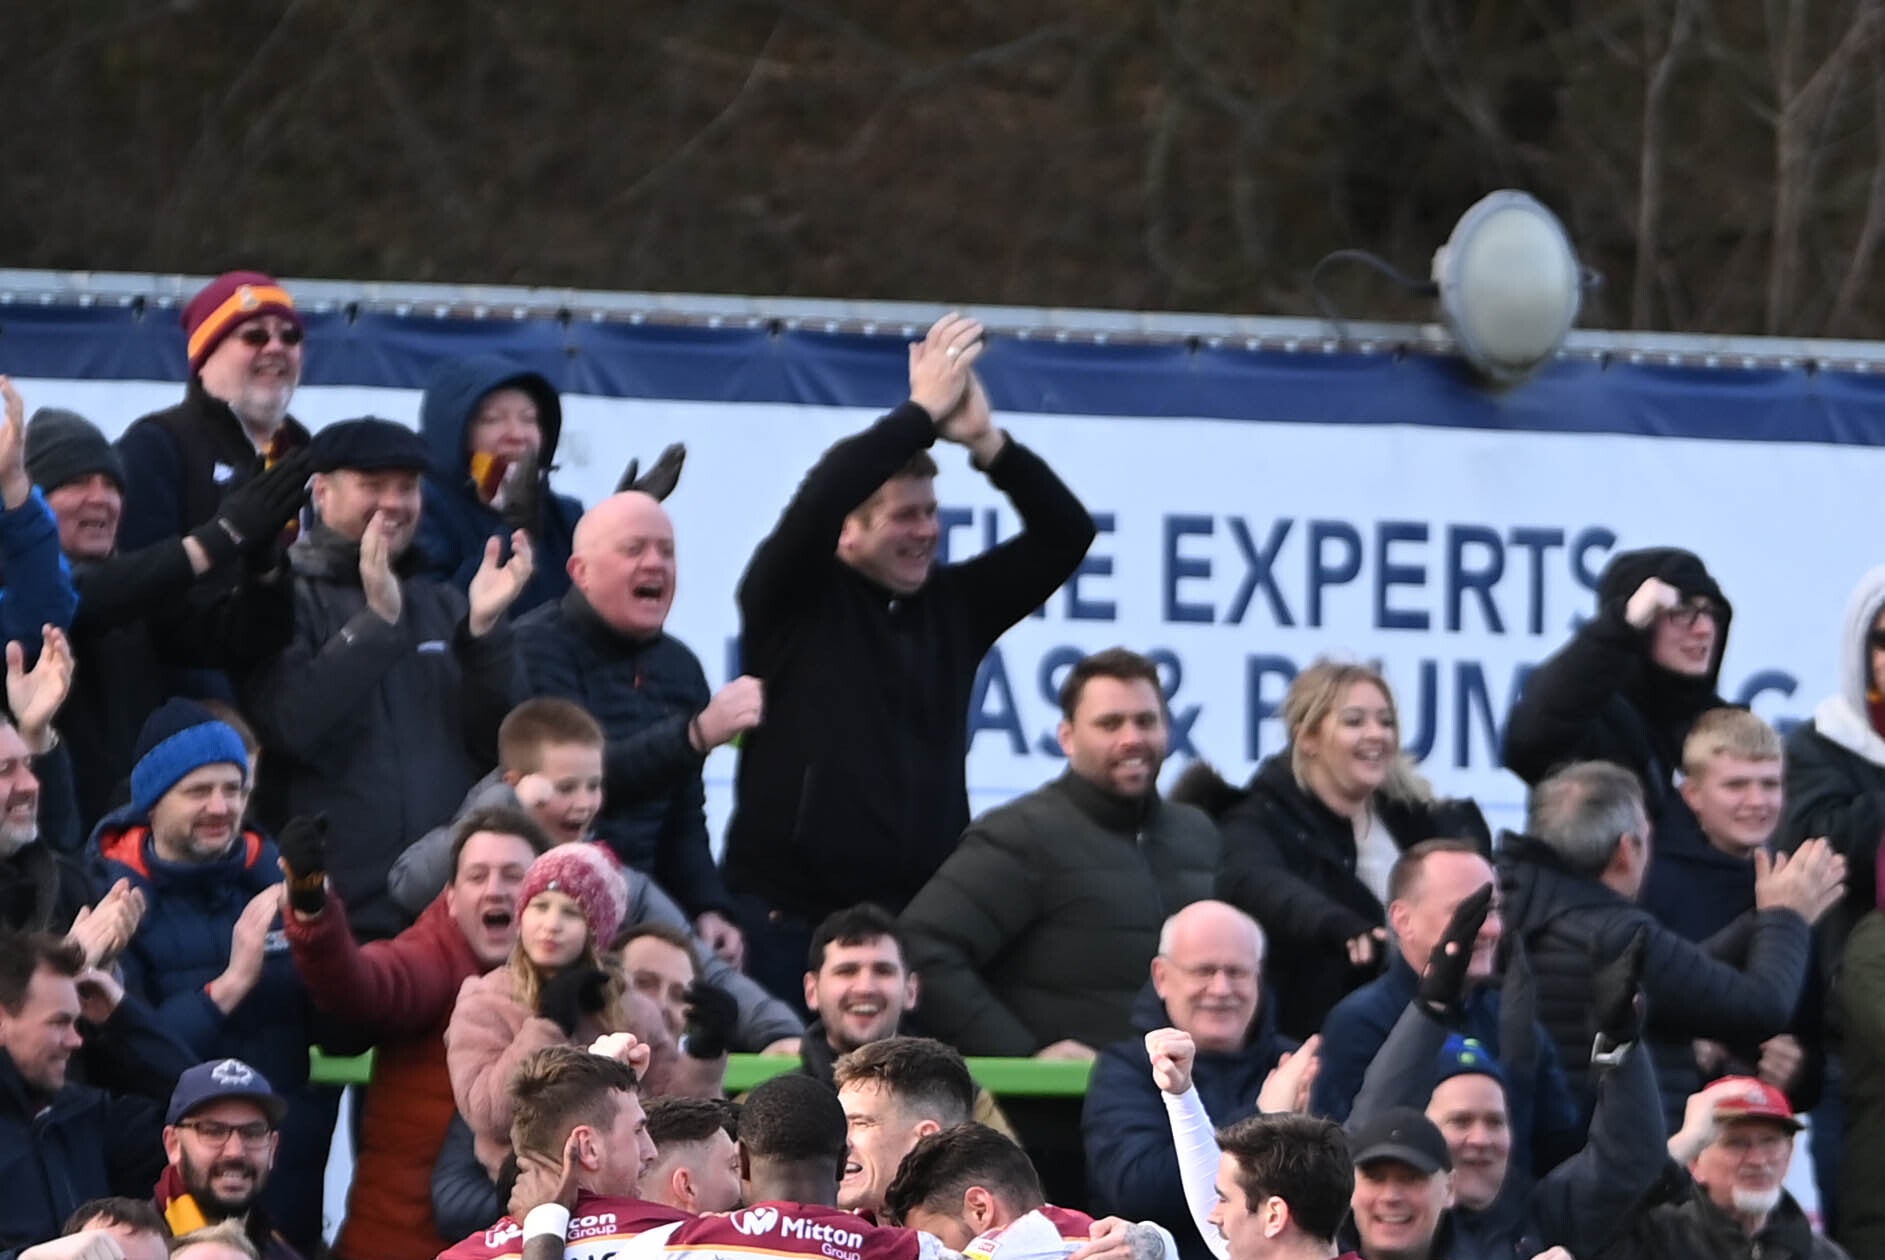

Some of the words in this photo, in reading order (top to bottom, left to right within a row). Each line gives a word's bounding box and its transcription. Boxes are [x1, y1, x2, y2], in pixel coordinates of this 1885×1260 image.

[935, 508, 1116, 620] TE
[1162, 513, 1618, 635] EXPERTS
[781, 1215, 863, 1249] Mitton
